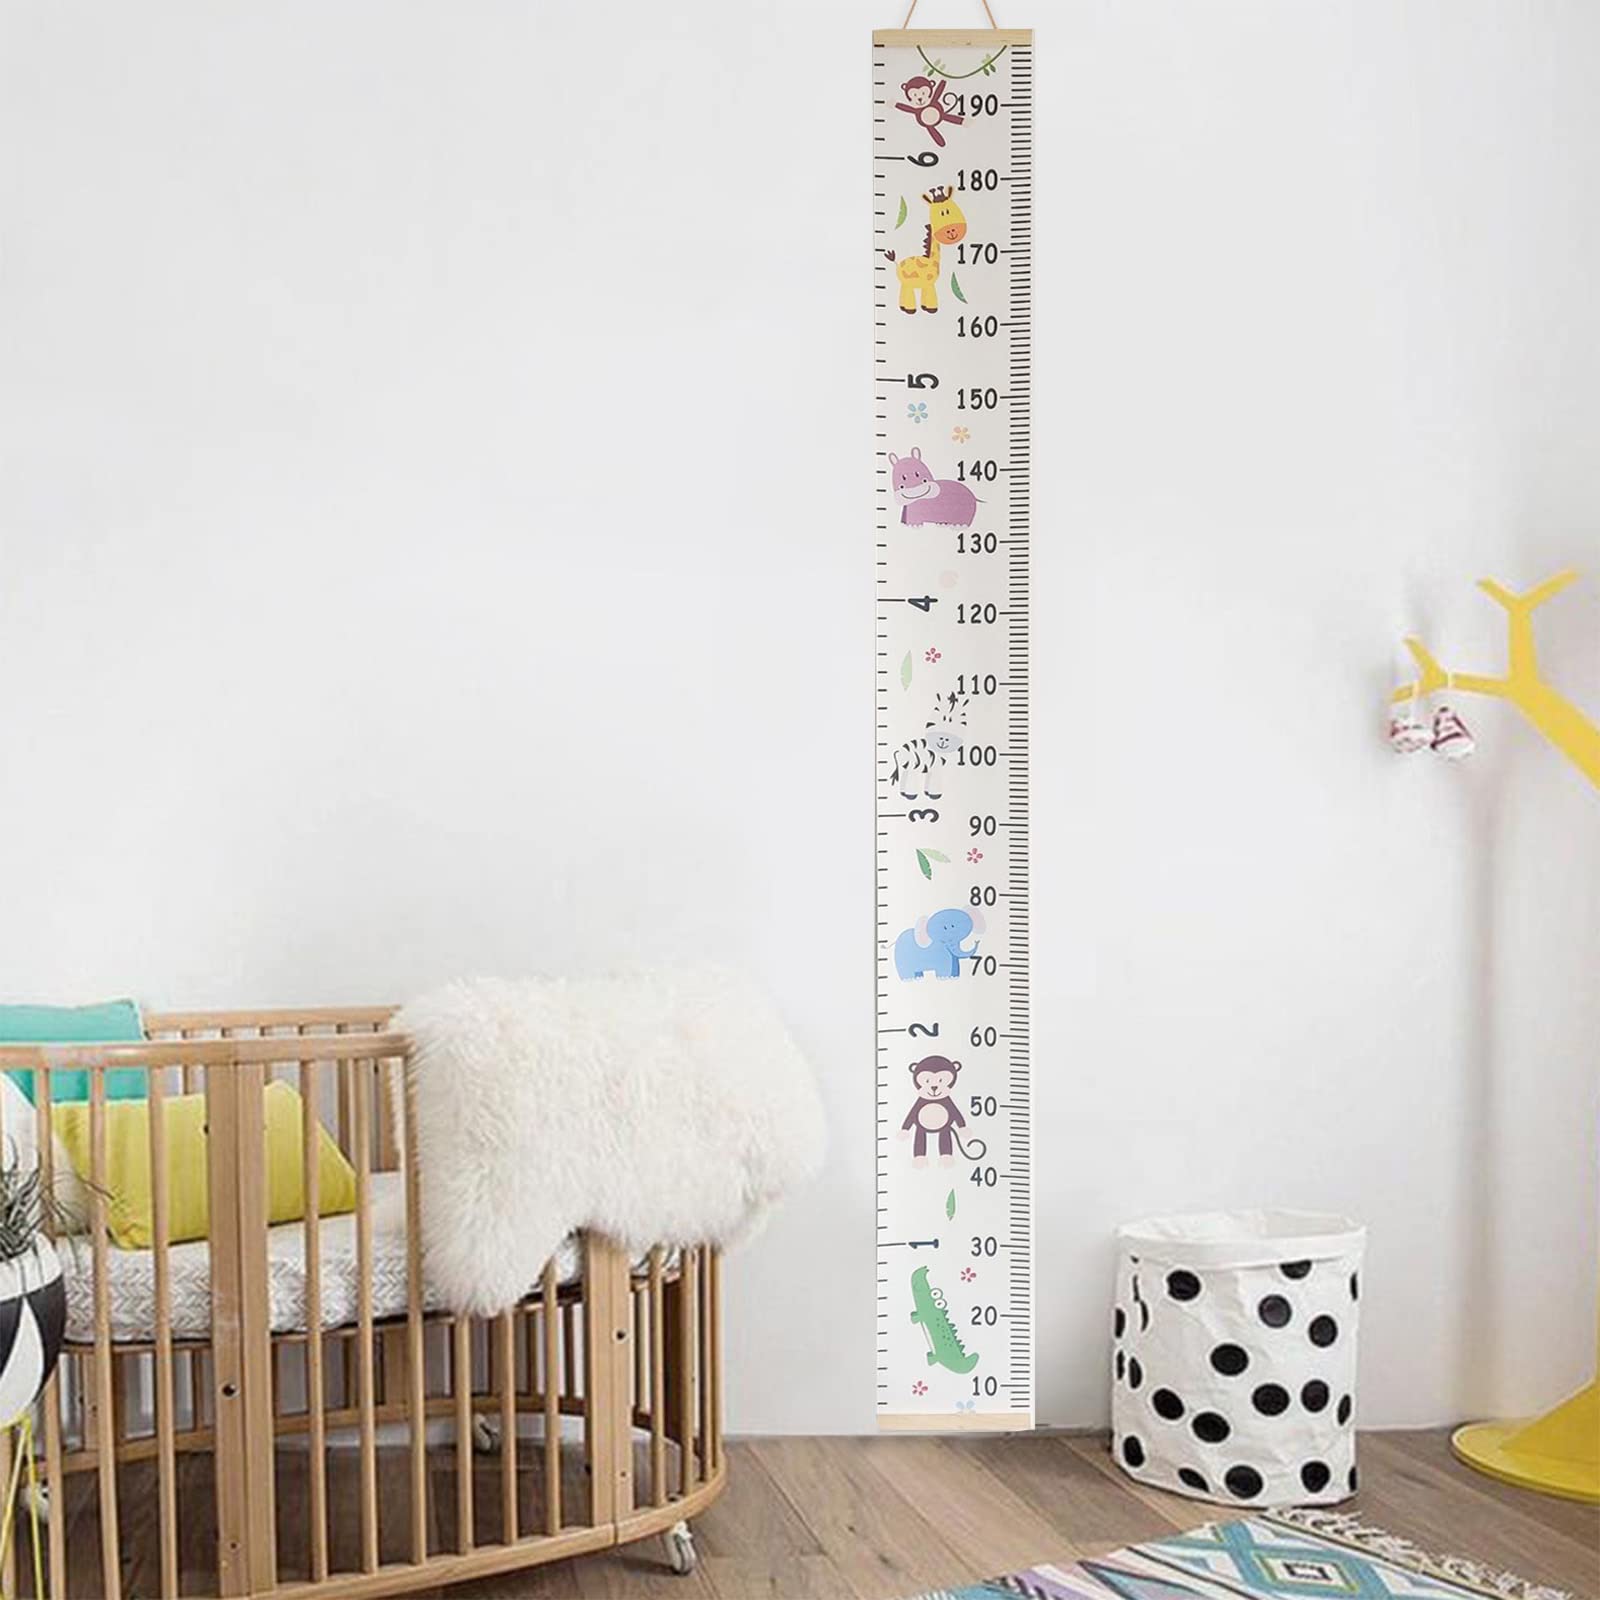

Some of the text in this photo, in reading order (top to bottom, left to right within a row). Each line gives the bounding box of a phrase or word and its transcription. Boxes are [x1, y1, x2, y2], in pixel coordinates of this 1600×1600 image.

[957, 94, 998, 117] 190
[907, 151, 939, 168] 6
[957, 169, 998, 191] 180
[957, 243, 998, 265] 170
[957, 316, 998, 338] 160
[907, 373, 940, 390] 5
[957, 388, 998, 410] 150
[957, 460, 998, 482] 140
[957, 532, 997, 554] 130
[907, 595, 939, 613] 4
[957, 603, 997, 624] 120
[957, 674, 997, 695] 110
[957, 745, 997, 766] 100
[908, 808, 940, 823] 3
[969, 815, 997, 836] 90
[969, 886, 997, 907] 80
[969, 955, 997, 976] 70
[908, 1022, 939, 1038] 2
[970, 1026, 997, 1047] 60
[970, 1096, 997, 1117] 50
[970, 1166, 997, 1187] 40
[908, 1238, 940, 1249] 1
[970, 1236, 997, 1257] 30
[970, 1305, 997, 1326] 20
[971, 1376, 997, 1396] 10
